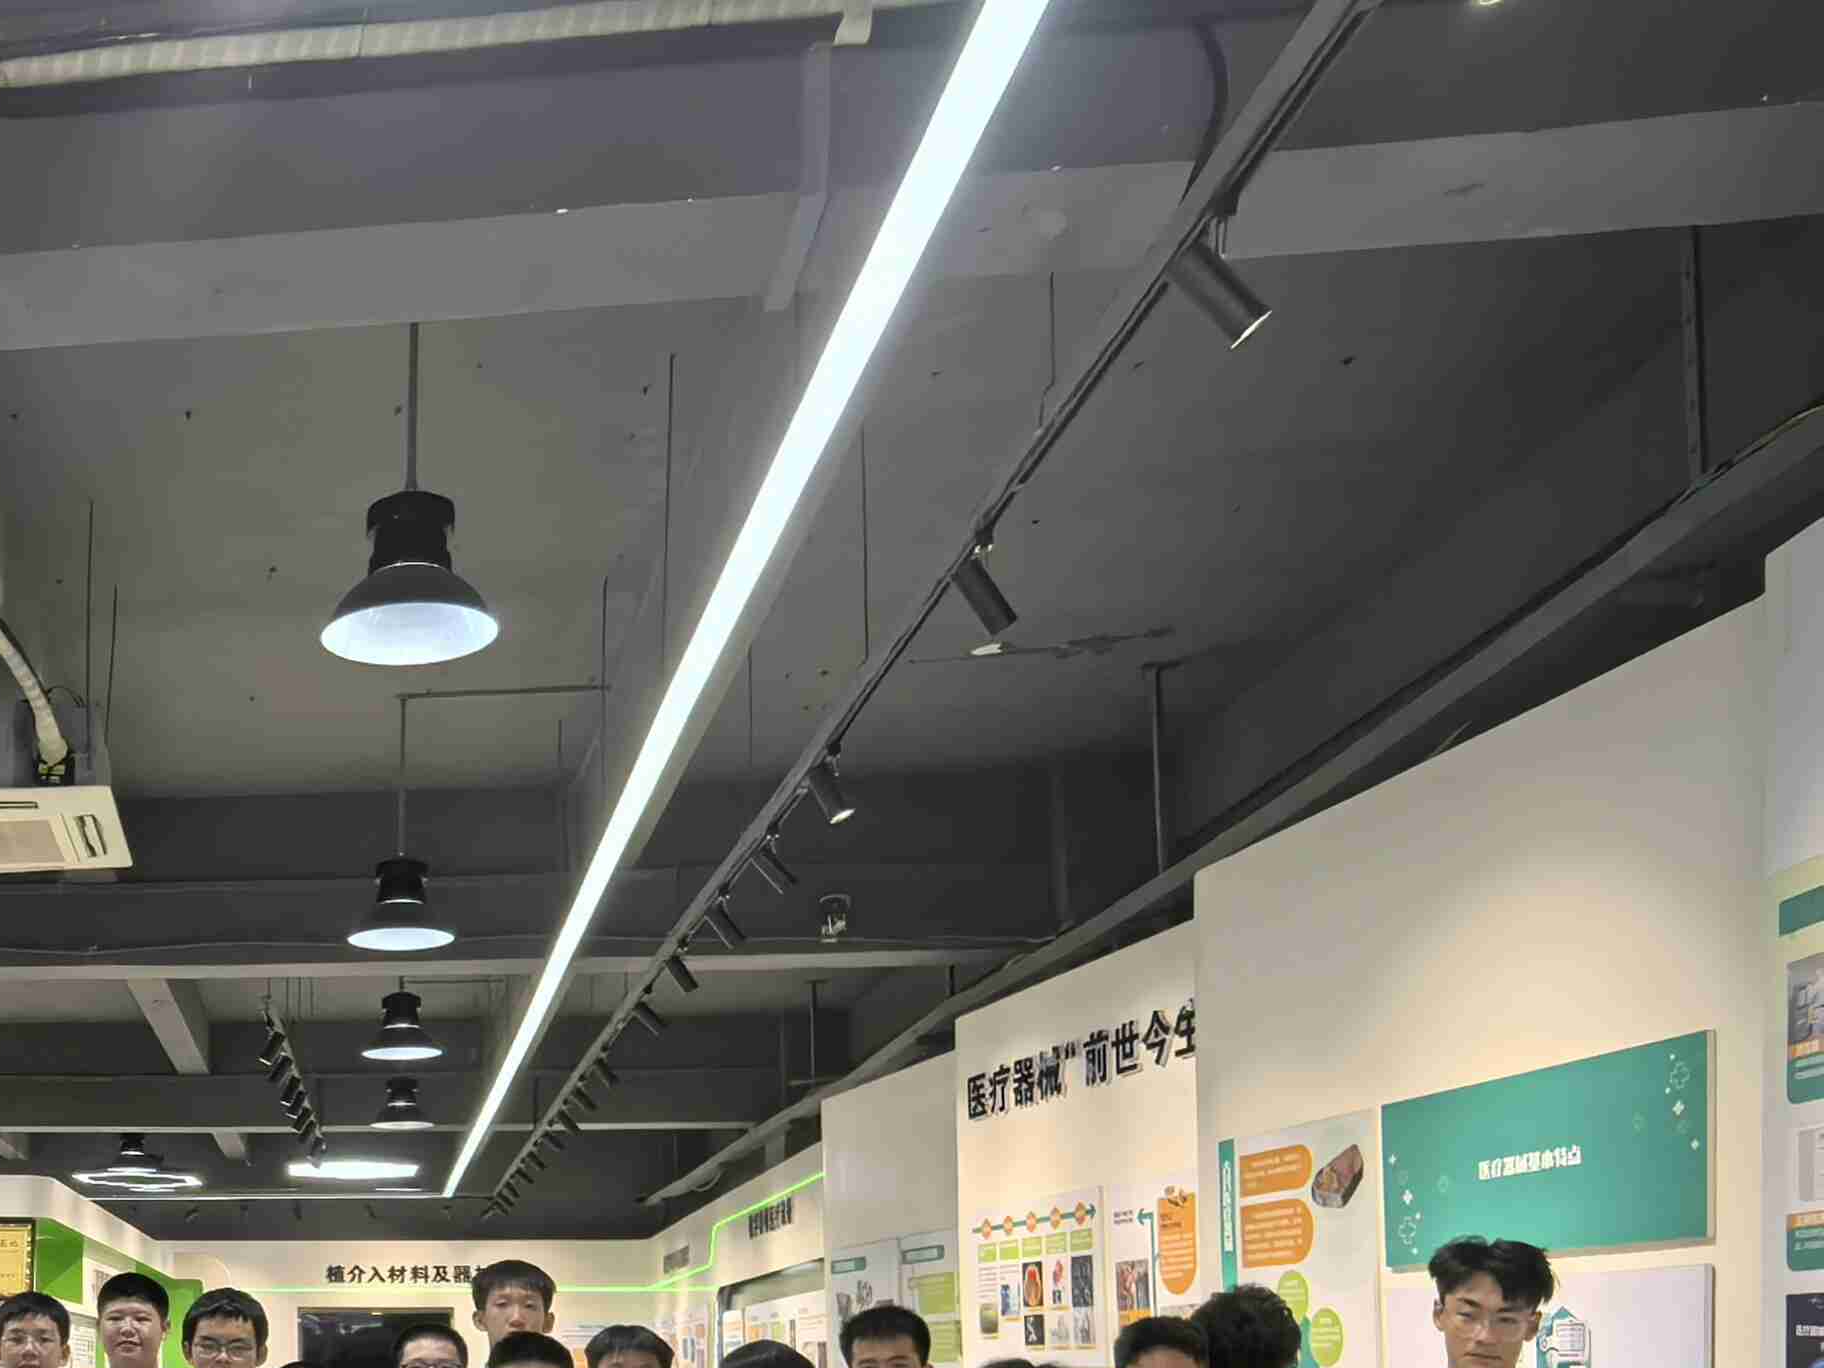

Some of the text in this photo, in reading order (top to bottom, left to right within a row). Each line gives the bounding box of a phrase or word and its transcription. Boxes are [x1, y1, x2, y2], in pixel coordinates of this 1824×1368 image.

[326, 1264, 487, 1284] 植介入材料及器
